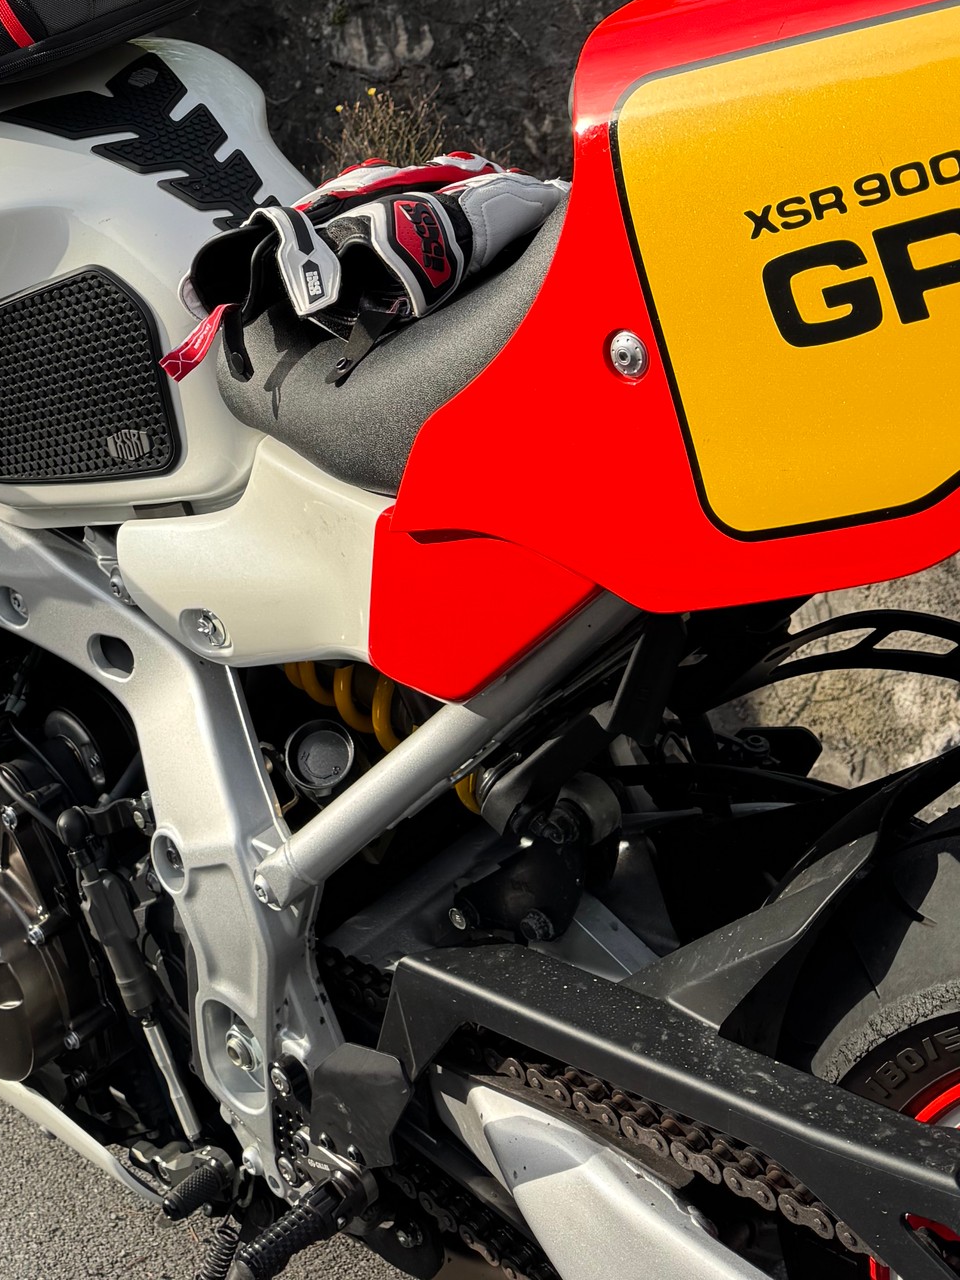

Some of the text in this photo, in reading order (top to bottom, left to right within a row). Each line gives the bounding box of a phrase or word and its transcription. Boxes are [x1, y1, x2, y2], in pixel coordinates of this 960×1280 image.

[743, 149, 960, 240] XSR 900
[761, 207, 960, 349] GP
[113, 429, 143, 460] XSR
